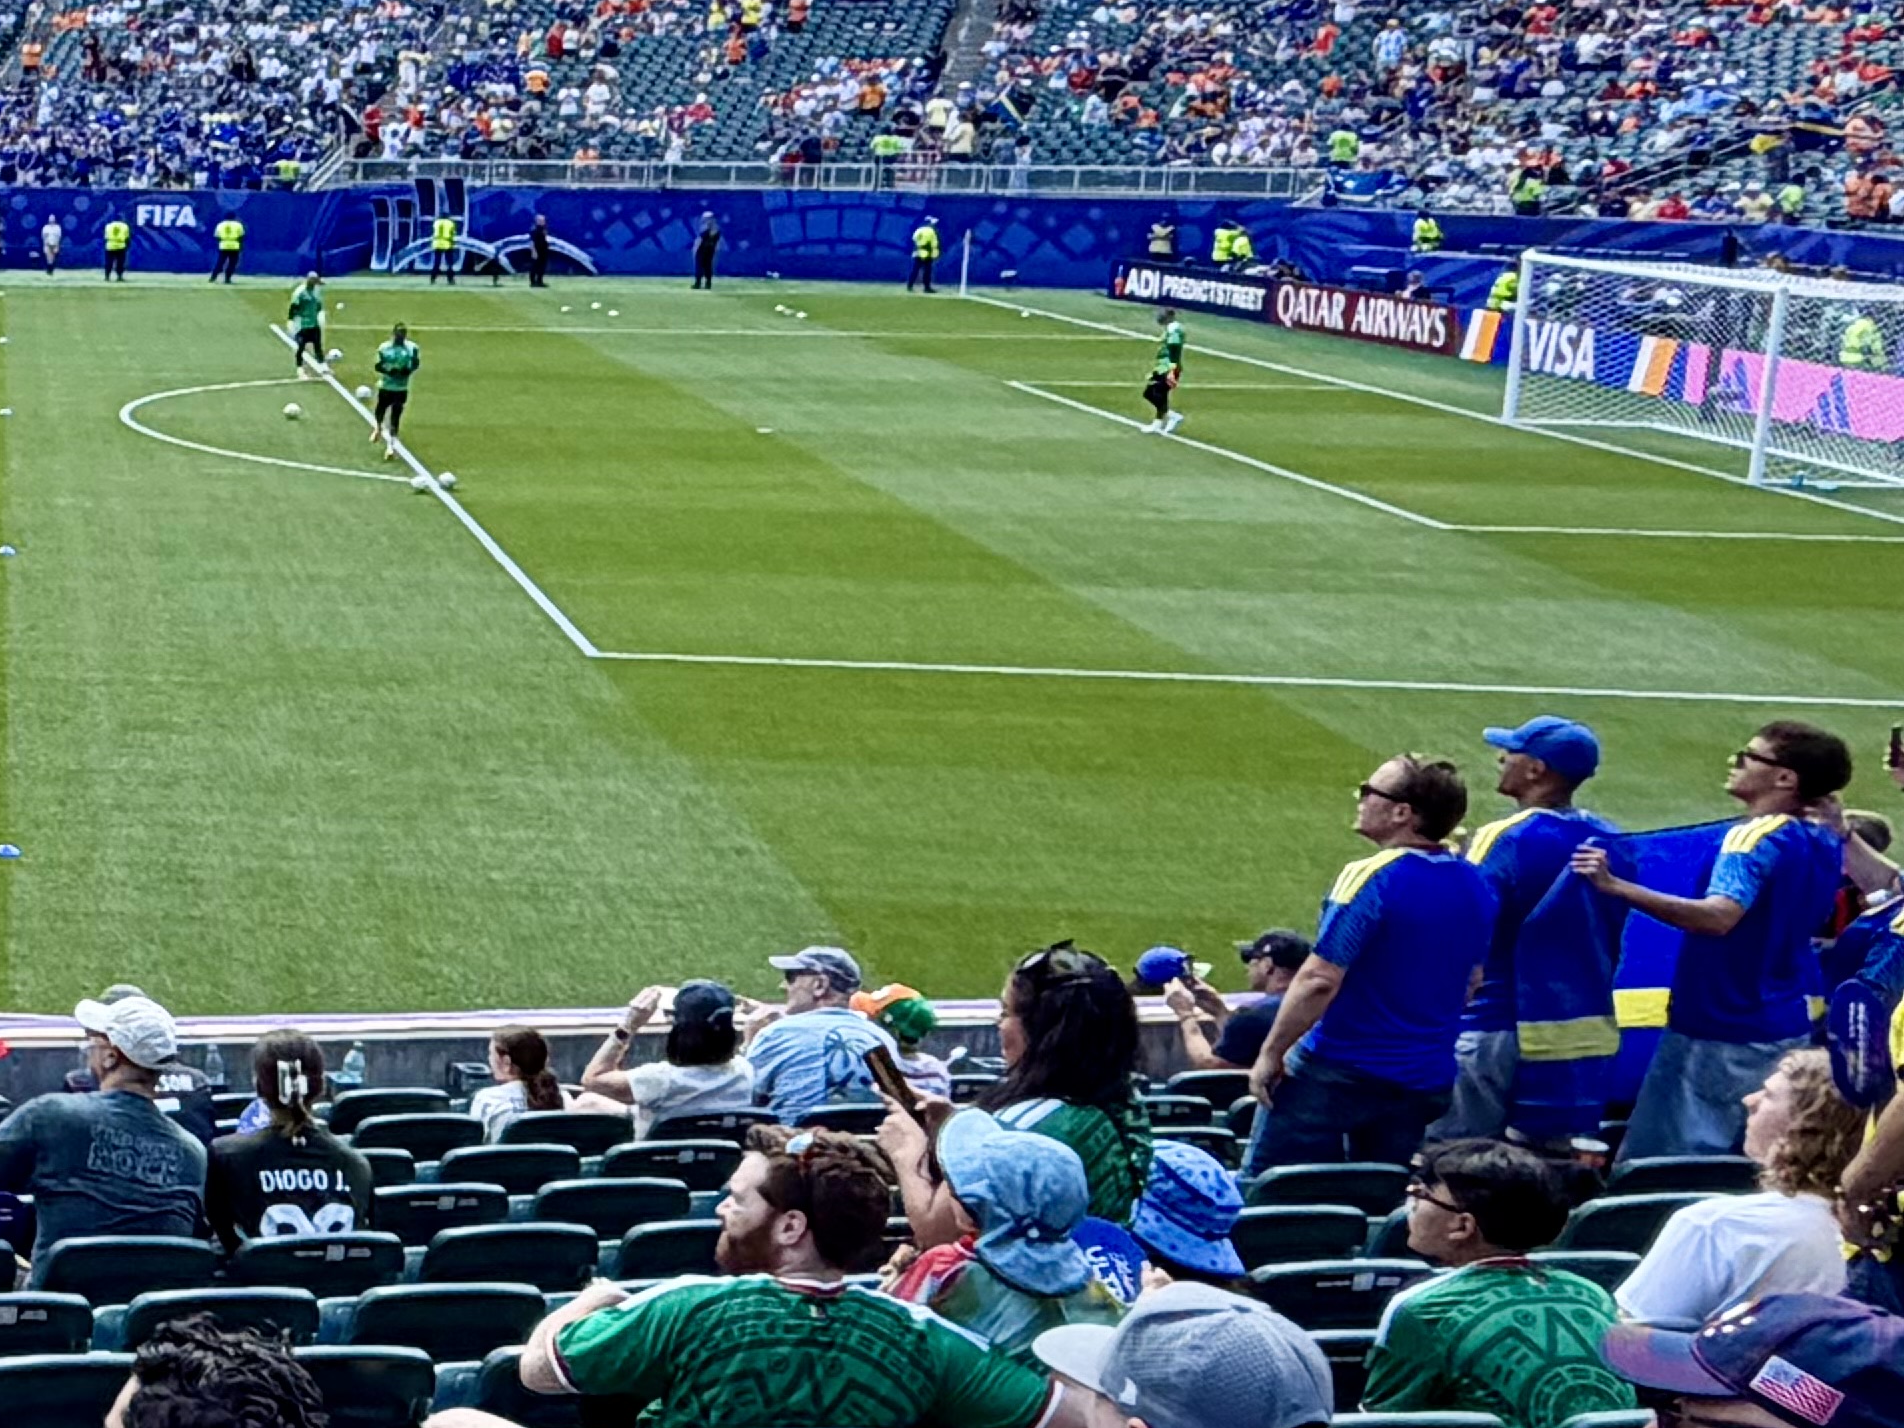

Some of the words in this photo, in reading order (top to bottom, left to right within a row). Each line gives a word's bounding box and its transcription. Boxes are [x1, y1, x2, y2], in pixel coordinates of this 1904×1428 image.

[136, 203, 197, 227] FIFA
[1276, 284, 1346, 331] QATAR
[1351, 296, 1448, 349] AIRWAYS
[1525, 319, 1597, 380] VISA
[259, 1169, 329, 1193] DIOGO
